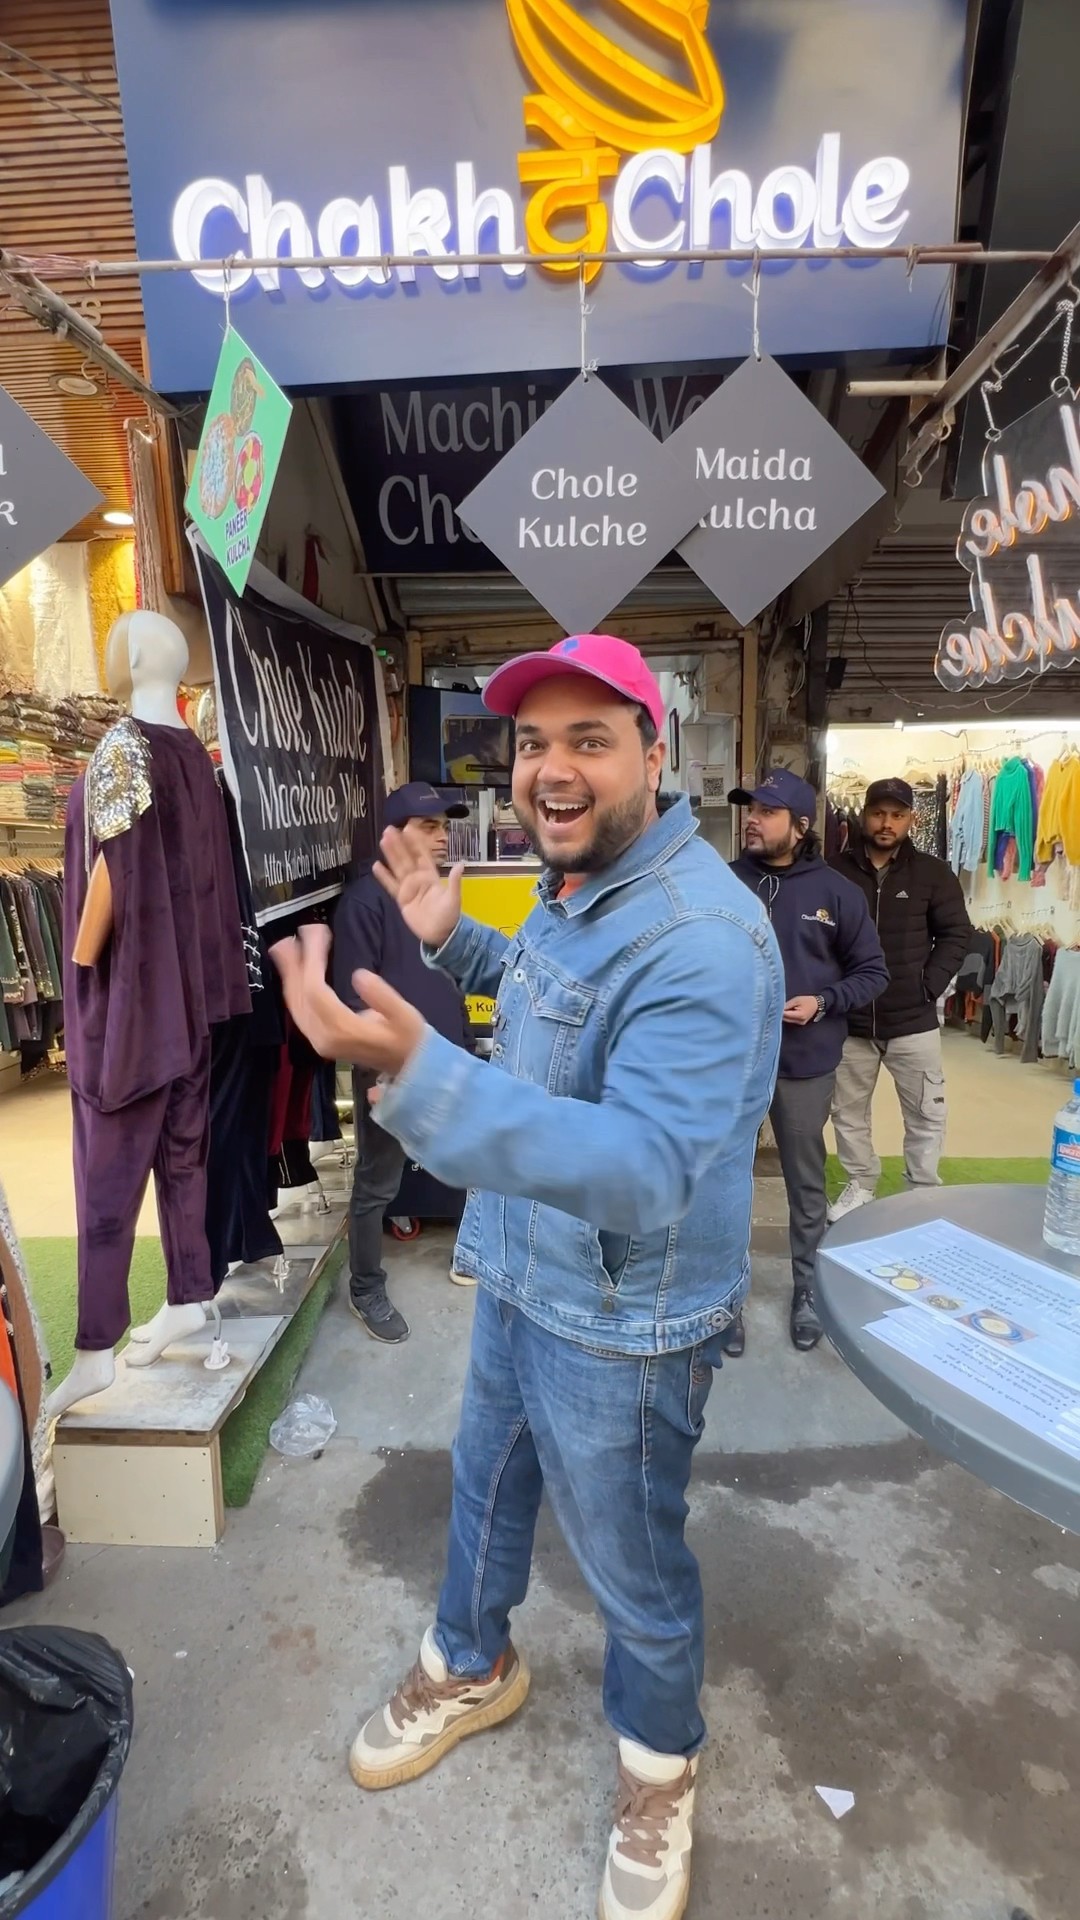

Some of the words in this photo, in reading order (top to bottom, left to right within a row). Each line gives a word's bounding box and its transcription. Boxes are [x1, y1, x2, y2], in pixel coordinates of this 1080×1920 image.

[172, 161, 526, 293] Chakh
[612, 132, 910, 267] Chole
[379, 384, 556, 455] Machi
[696, 447, 812, 481] Maida
[531, 466, 638, 500] Chole
[225, 507, 249, 542] PANEER
[518, 515, 647, 548] Kulche
[699, 497, 817, 531] ulcha
[226, 534, 250, 567] KULCHA
[226, 598, 311, 754] Chole
[254, 766, 338, 830] Machine
[264, 852, 283, 887] Atta
